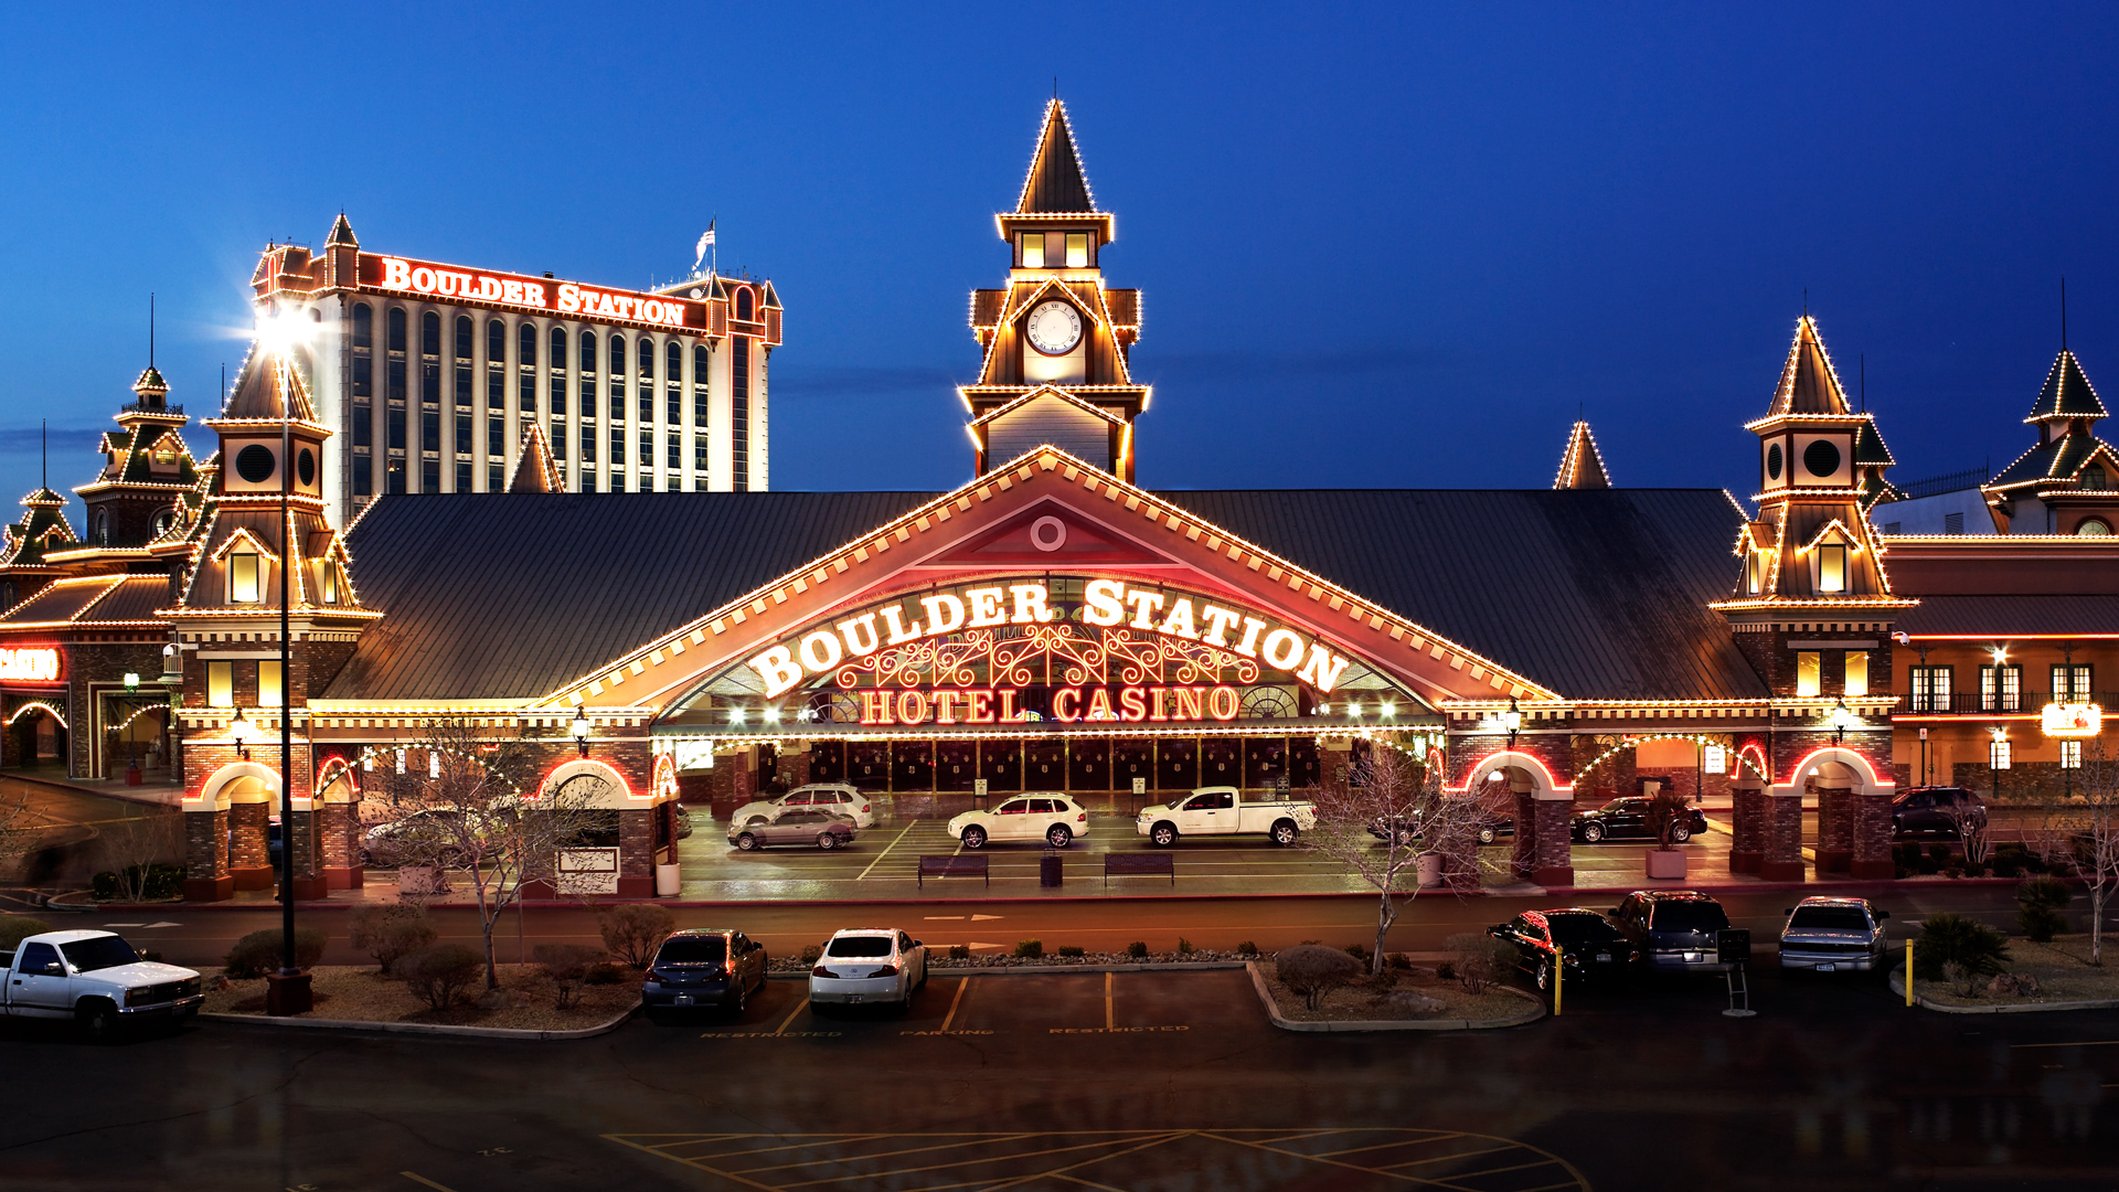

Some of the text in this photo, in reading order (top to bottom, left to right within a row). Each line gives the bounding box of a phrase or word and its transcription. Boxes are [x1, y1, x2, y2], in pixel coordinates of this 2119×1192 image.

[381, 258, 685, 326] BOULDER STATION
[748, 580, 1350, 699] BOULDER STATION
[860, 687, 1028, 726] HOTEL
[1053, 685, 1243, 724] CASINO
[699, 1031, 843, 1039] RESTRICTED
[898, 1028, 995, 1037] PARKING
[1049, 1024, 1190, 1035] RESTRICTED
